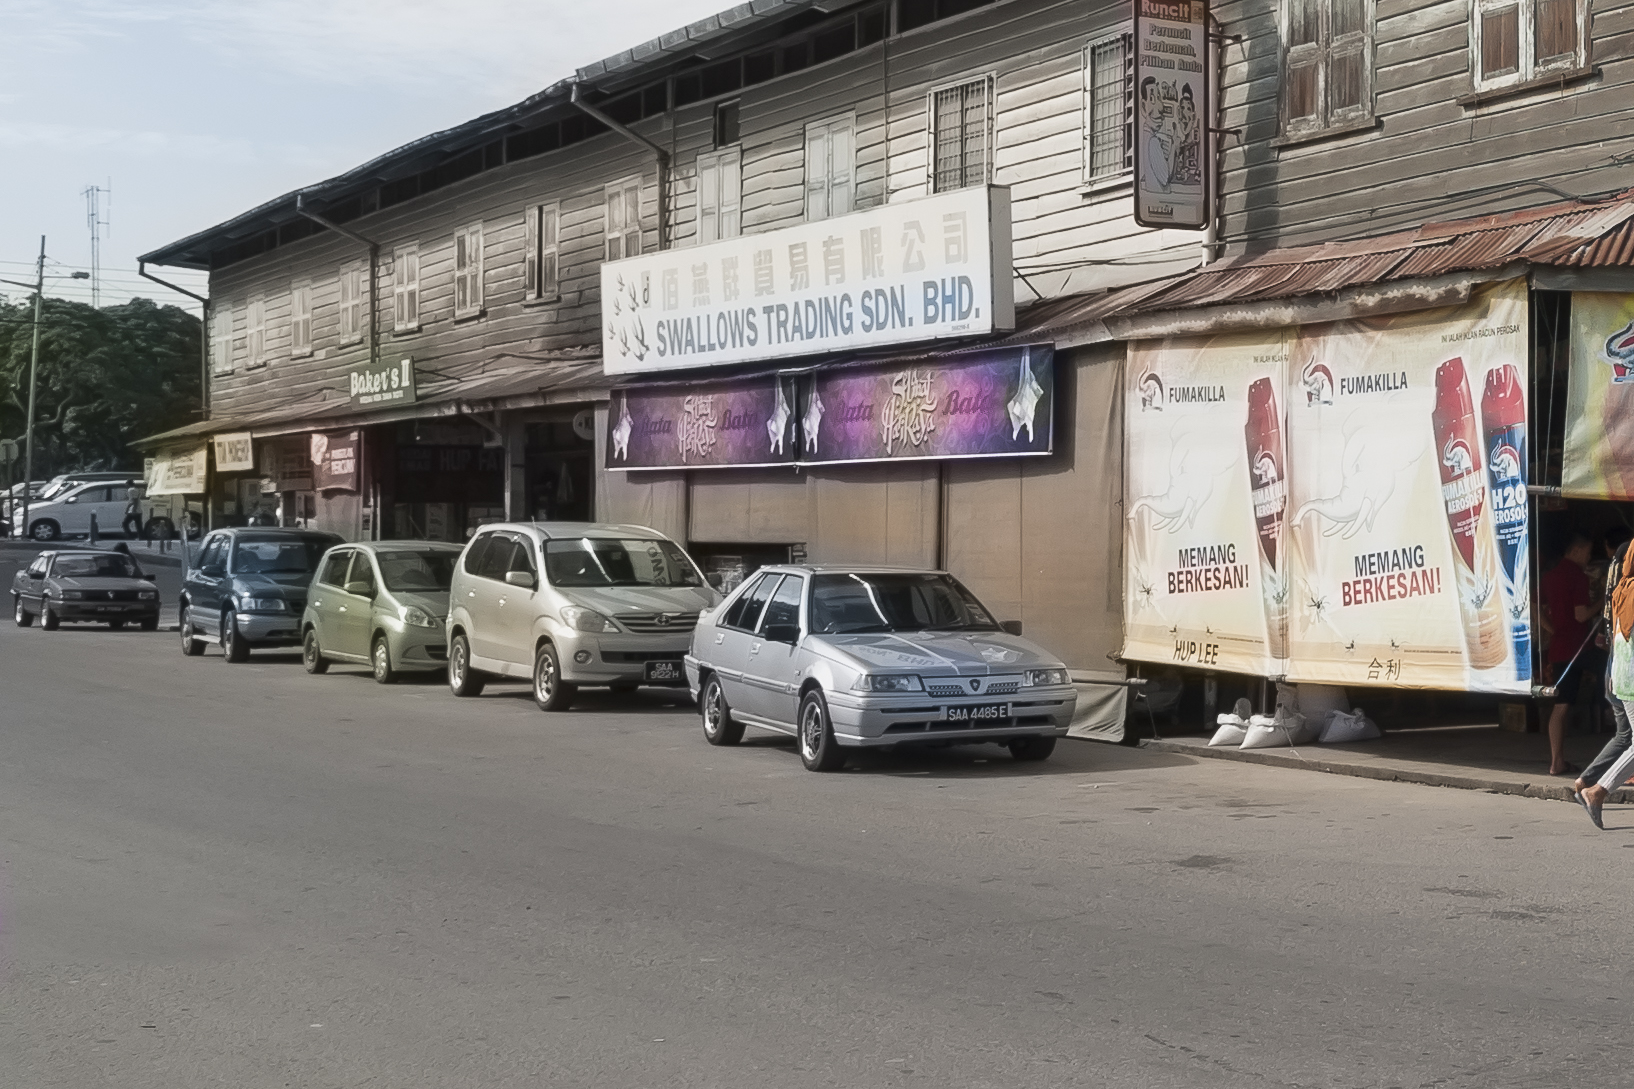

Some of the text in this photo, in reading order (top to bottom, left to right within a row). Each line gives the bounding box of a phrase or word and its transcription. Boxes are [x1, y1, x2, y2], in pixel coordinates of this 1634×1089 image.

[1178, 58, 1203, 73] Anda
[656, 274, 981, 358] SWALLOWS TRADING SDN. BHD.
[1479, 327, 1496, 339] RACUN
[1496, 323, 1521, 336] PEROSAK
[350, 367, 399, 397] Baker's
[1168, 385, 1226, 403] FUMAKILLA
[1340, 371, 1409, 396] FUMAKILLA
[1178, 543, 1236, 569] MEMANG
[1354, 545, 1425, 578] MEMANG
[1167, 564, 1249, 594] BERKESAN!
[1341, 567, 1442, 607] BERKESAN!
[1172, 639, 1219, 666] HUP LEE
[655, 662, 673, 671] SAA
[1366, 657, 1402, 682] 合利
[948, 705, 1007, 721] SAA 4485 E
